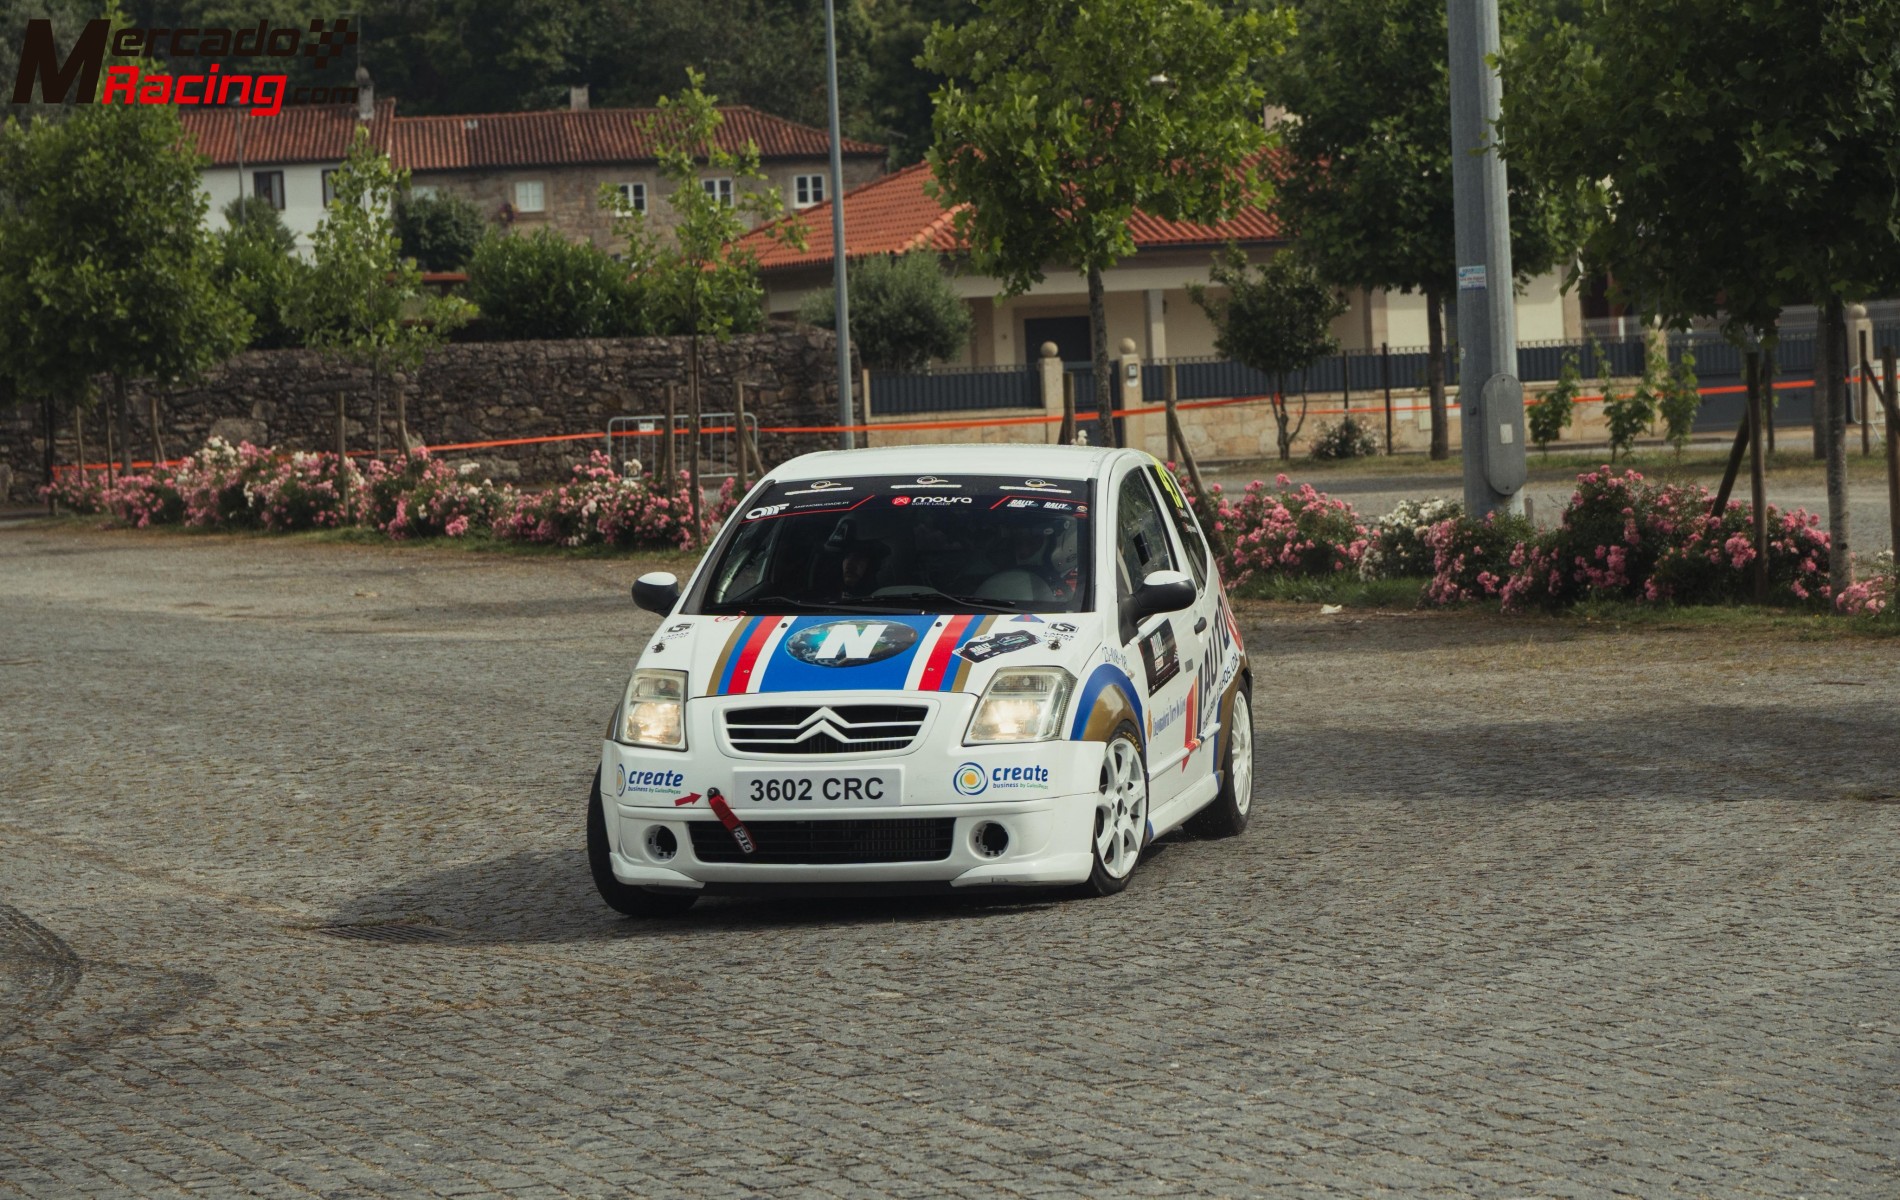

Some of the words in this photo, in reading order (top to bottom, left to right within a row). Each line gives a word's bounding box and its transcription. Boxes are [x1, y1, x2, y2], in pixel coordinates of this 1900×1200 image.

[912, 496, 973, 504] moura
[815, 620, 888, 658] N
[628, 769, 684, 787] create
[992, 764, 1049, 782] create
[750, 778, 813, 801] 3602
[822, 777, 884, 800] CRC
